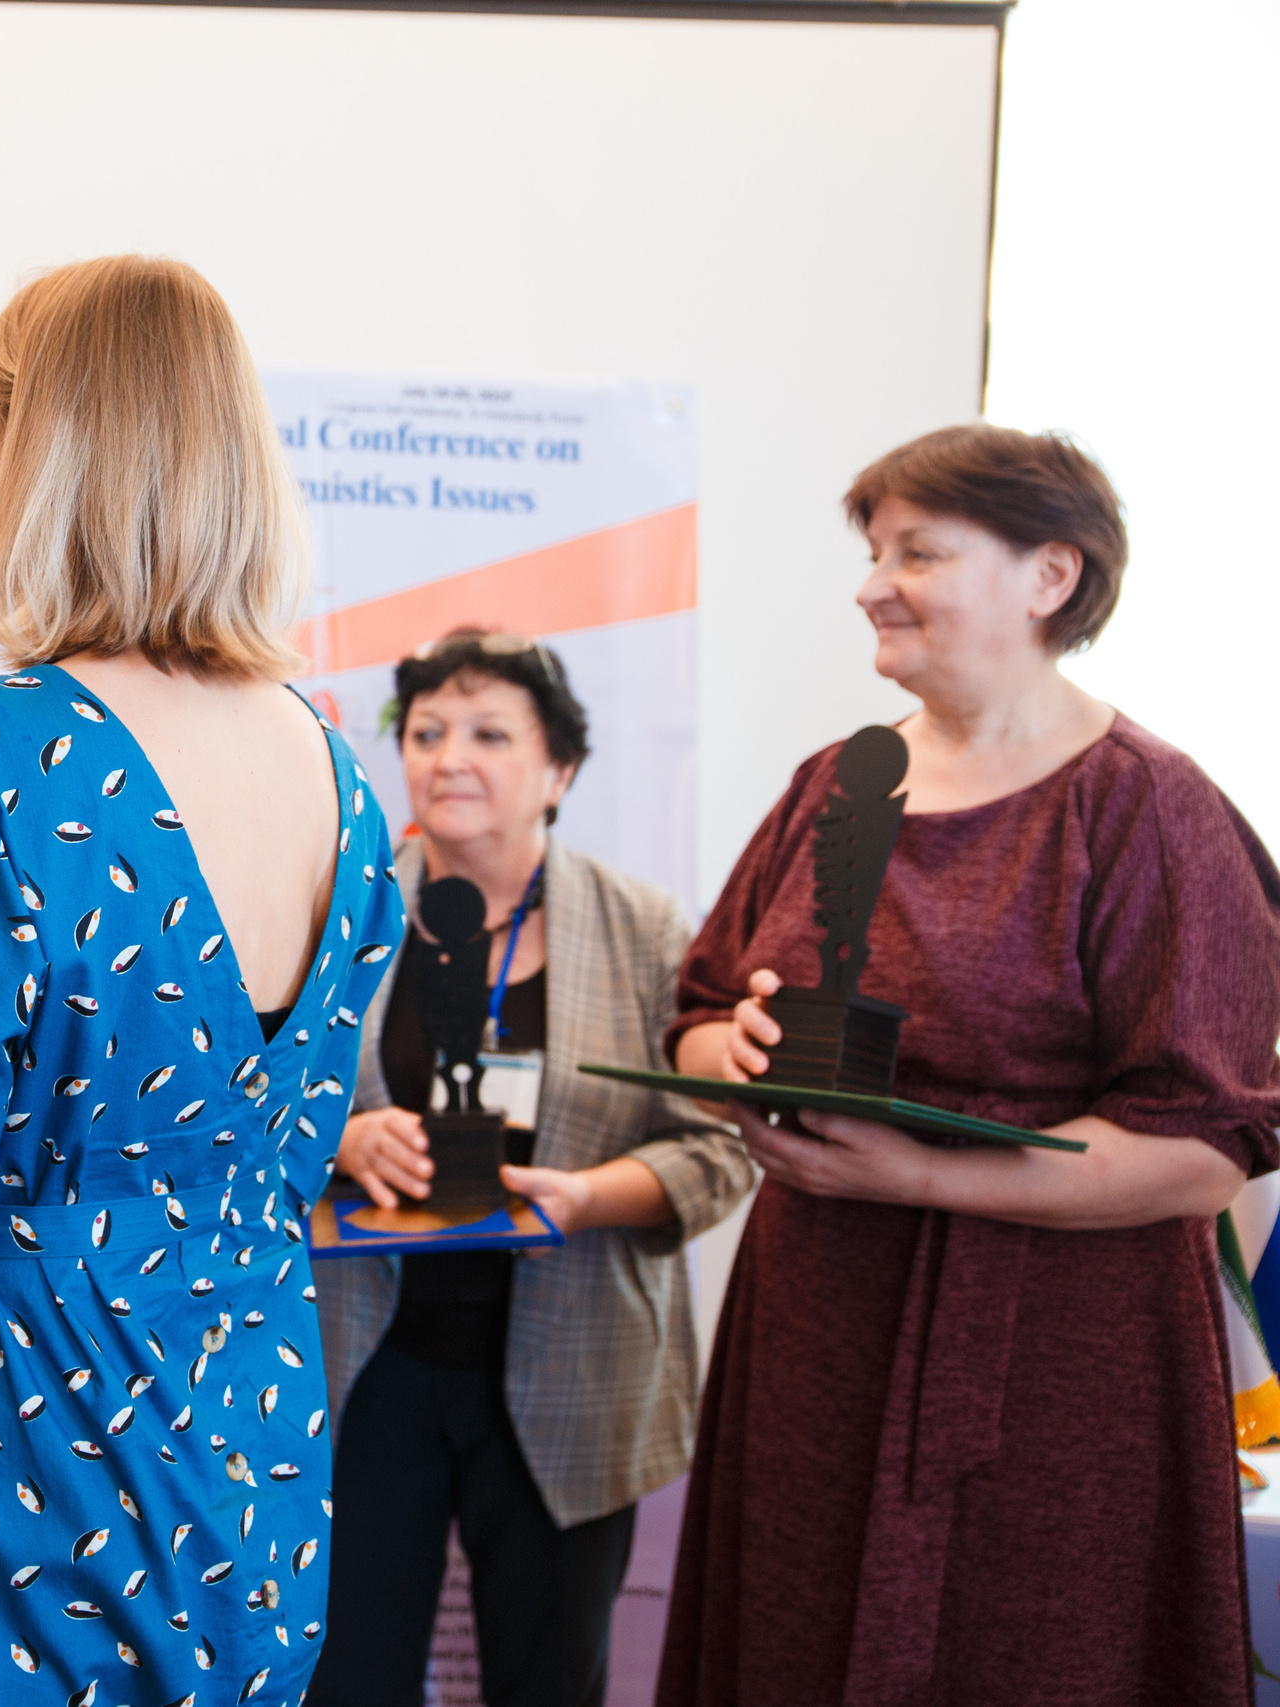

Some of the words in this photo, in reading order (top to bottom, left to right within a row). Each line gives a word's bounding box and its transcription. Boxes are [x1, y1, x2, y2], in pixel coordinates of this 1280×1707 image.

[318, 417, 526, 461] Conference
[536, 437, 581, 462] on
[431, 476, 536, 513] Issues
